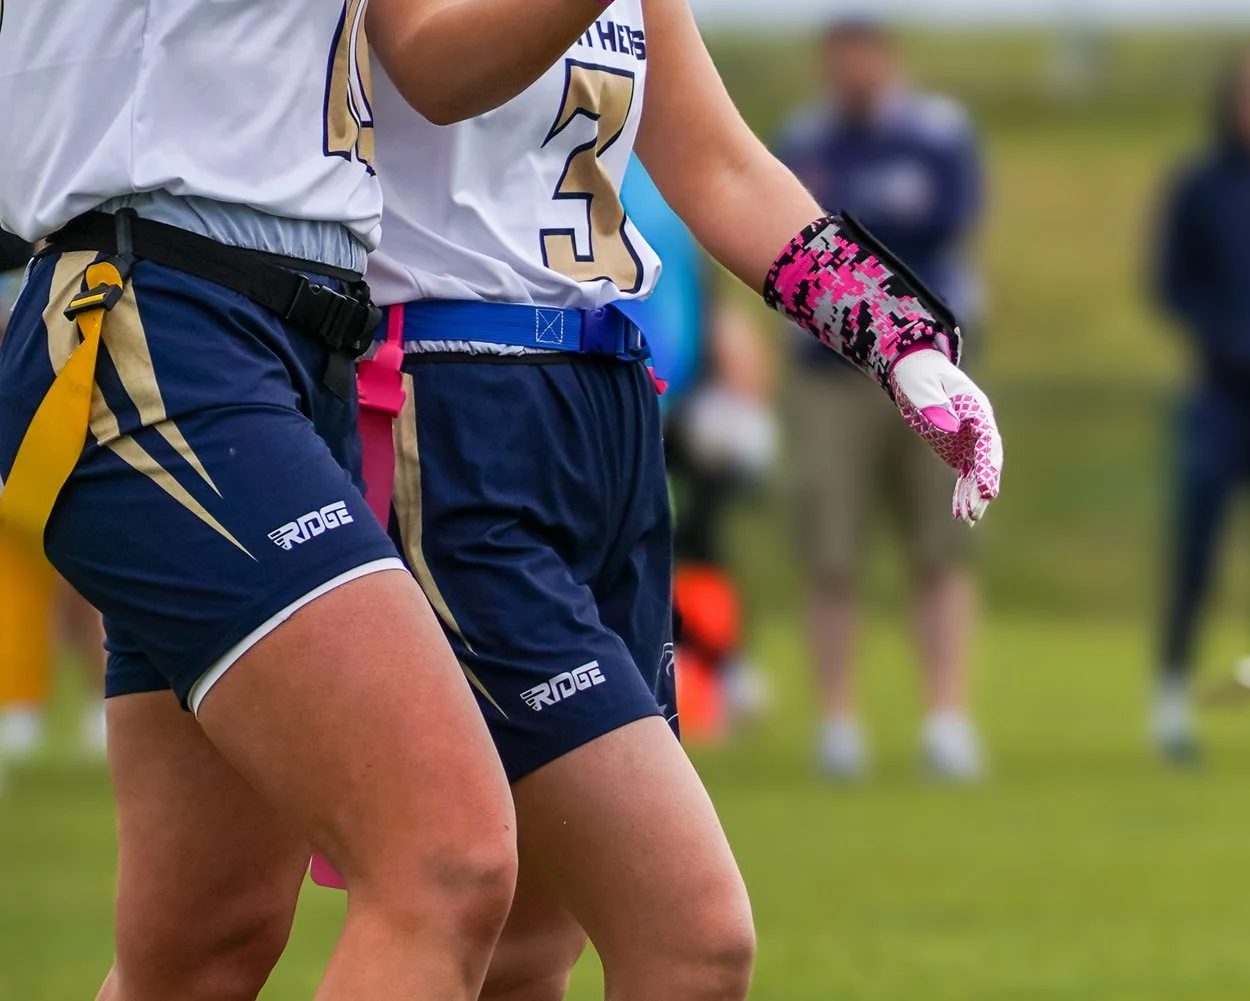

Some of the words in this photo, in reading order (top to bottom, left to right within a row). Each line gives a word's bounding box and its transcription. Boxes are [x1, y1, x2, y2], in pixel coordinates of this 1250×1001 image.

[539, 58, 643, 294] 3
[267, 500, 354, 551] RIDGE
[519, 660, 606, 712] RIDGE
